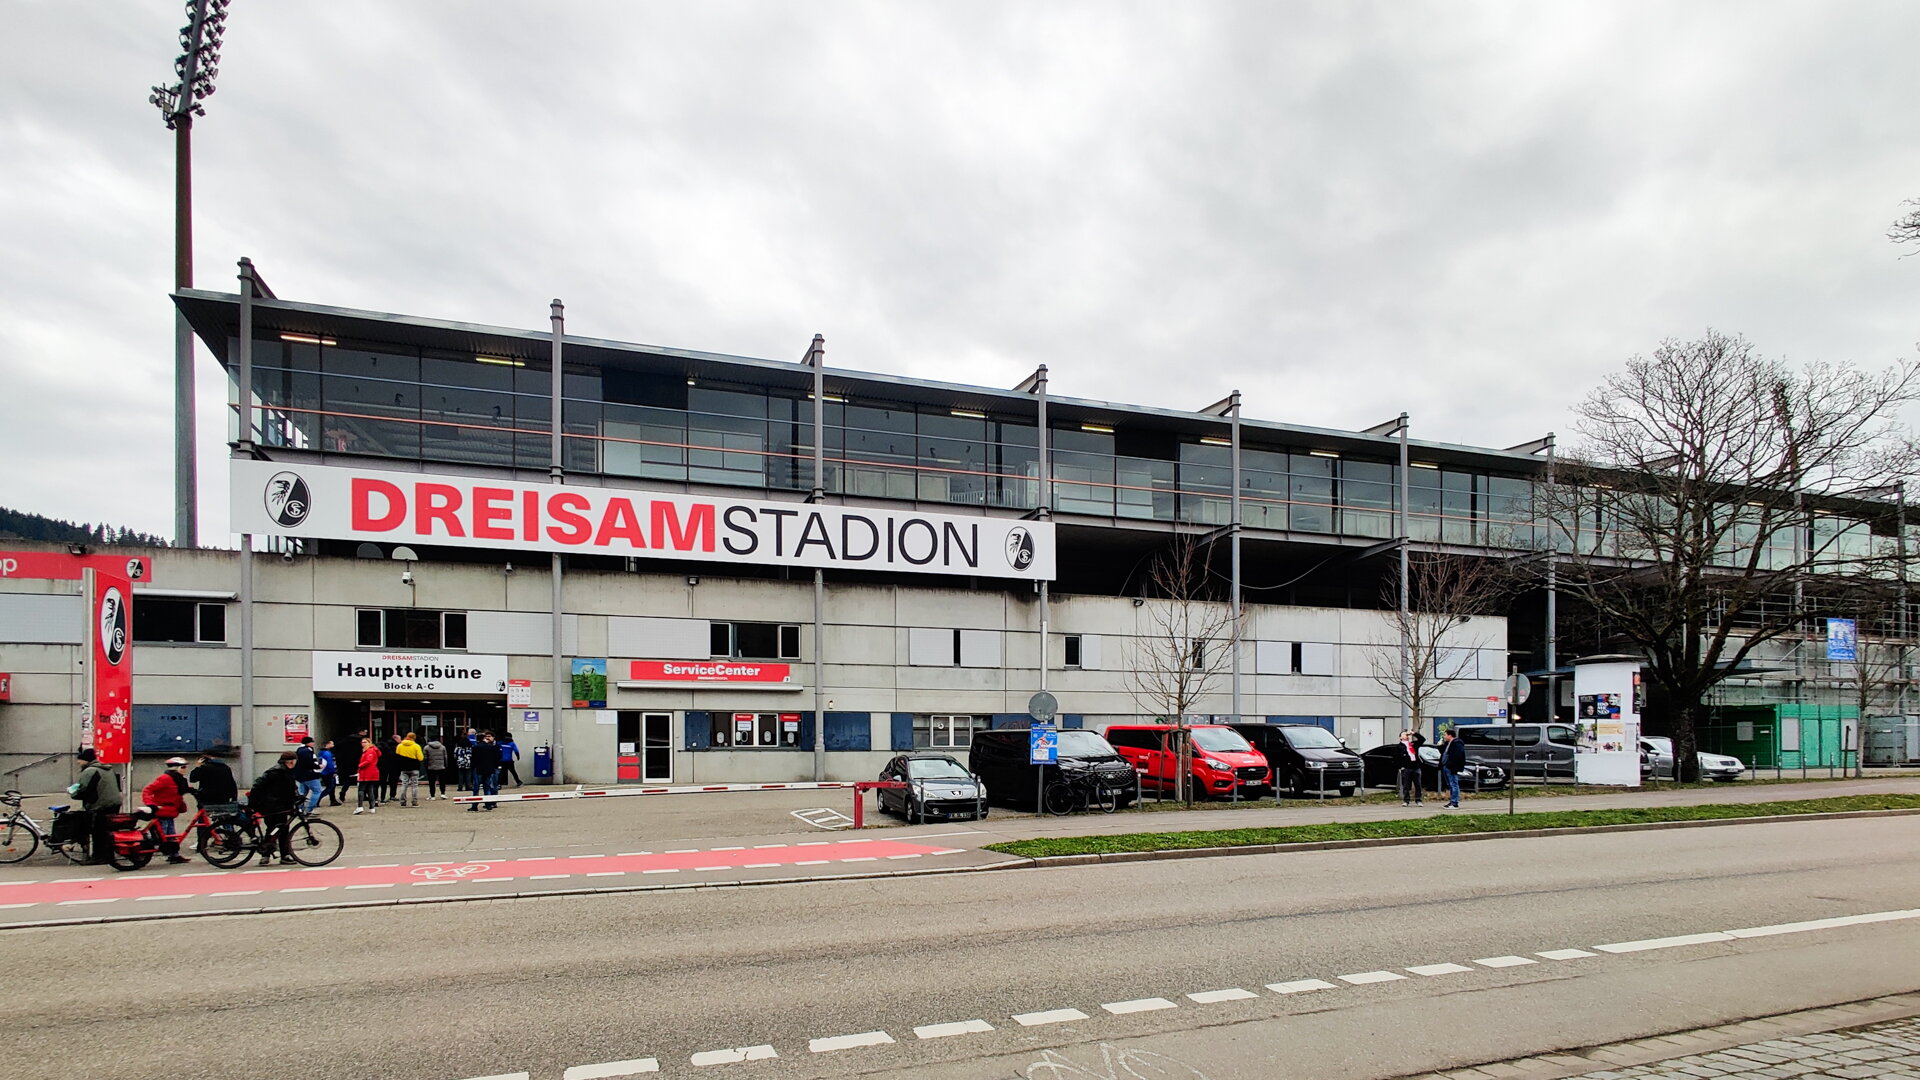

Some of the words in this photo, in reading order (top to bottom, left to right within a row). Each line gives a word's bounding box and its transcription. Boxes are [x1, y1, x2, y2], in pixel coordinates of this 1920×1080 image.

[351, 478, 978, 567] DREISAMSTADION
[337, 663, 482, 680] Haupttribüne
[663, 663, 761, 676] ServiceCenter
[384, 682, 412, 690] Block
